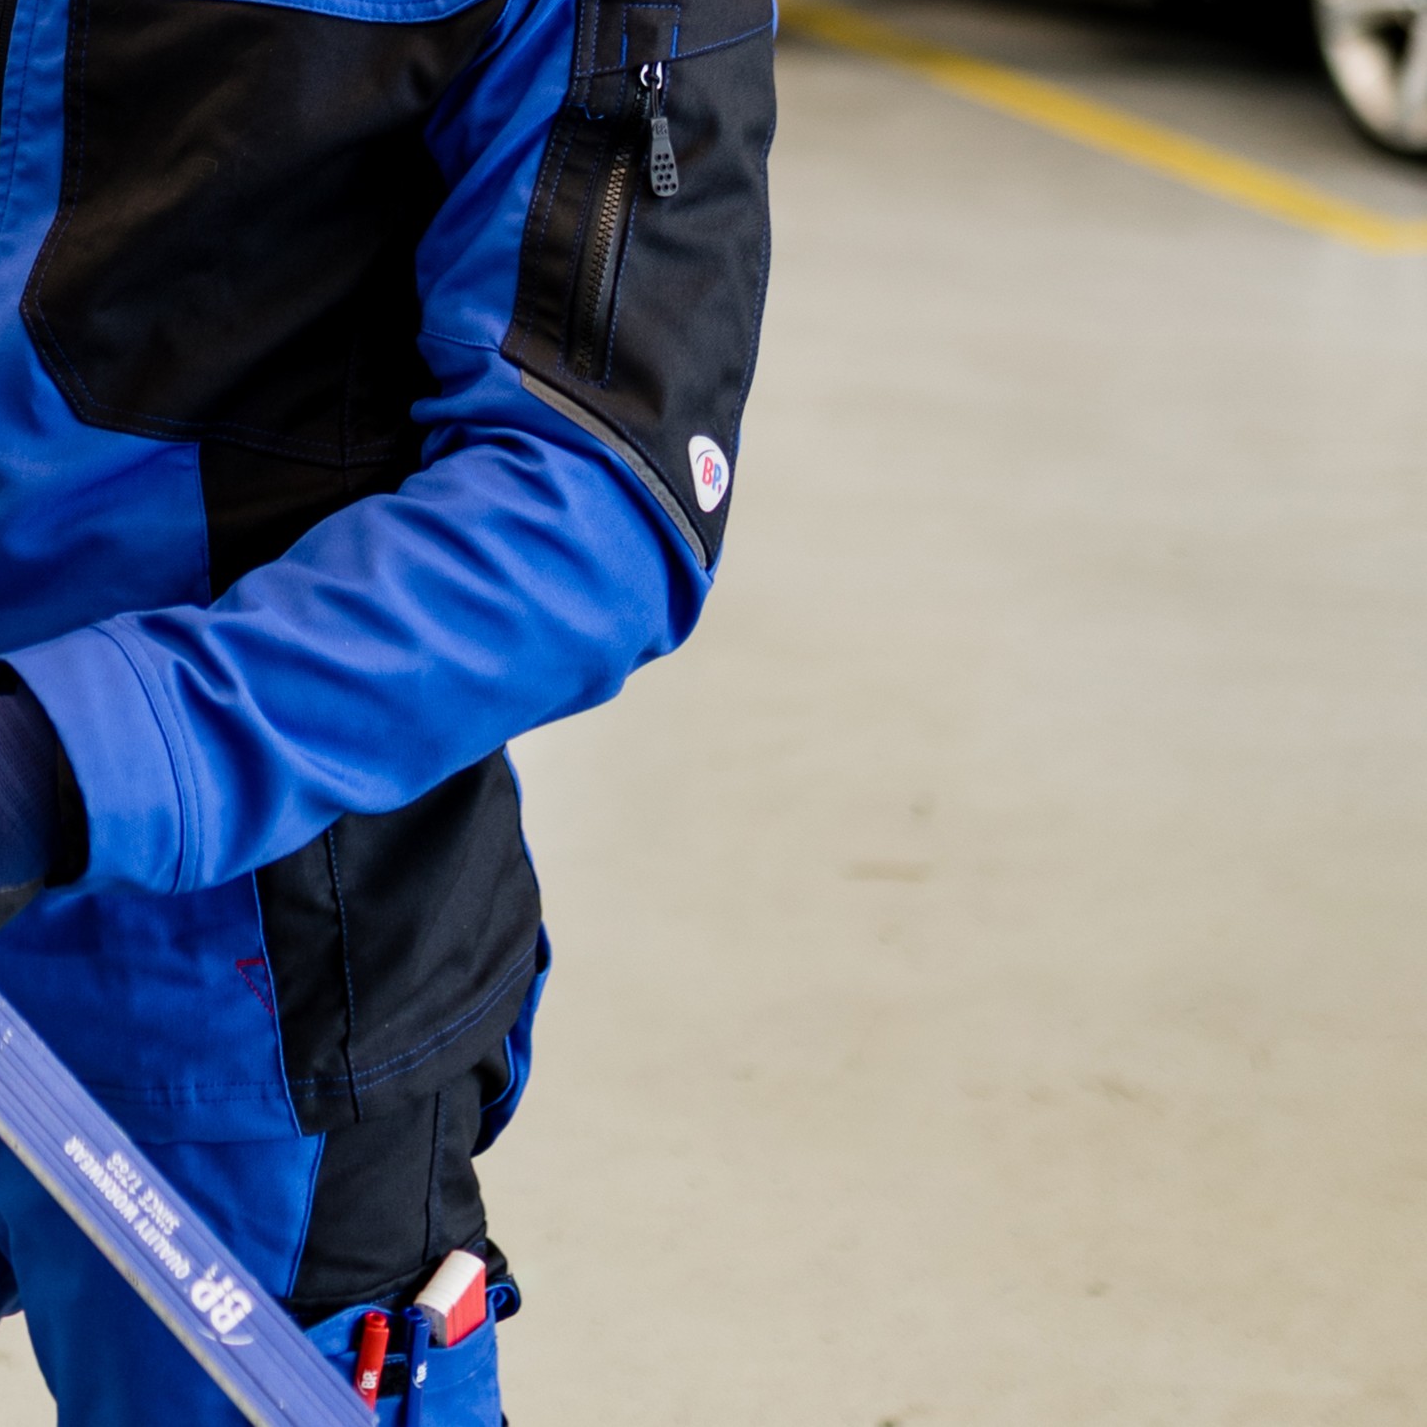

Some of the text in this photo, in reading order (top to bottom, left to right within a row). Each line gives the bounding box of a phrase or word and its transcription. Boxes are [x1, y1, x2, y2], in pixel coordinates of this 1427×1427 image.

[64, 1135, 190, 1279] QUALITY WORKWEAR
[138, 1187, 180, 1235] SINCE
